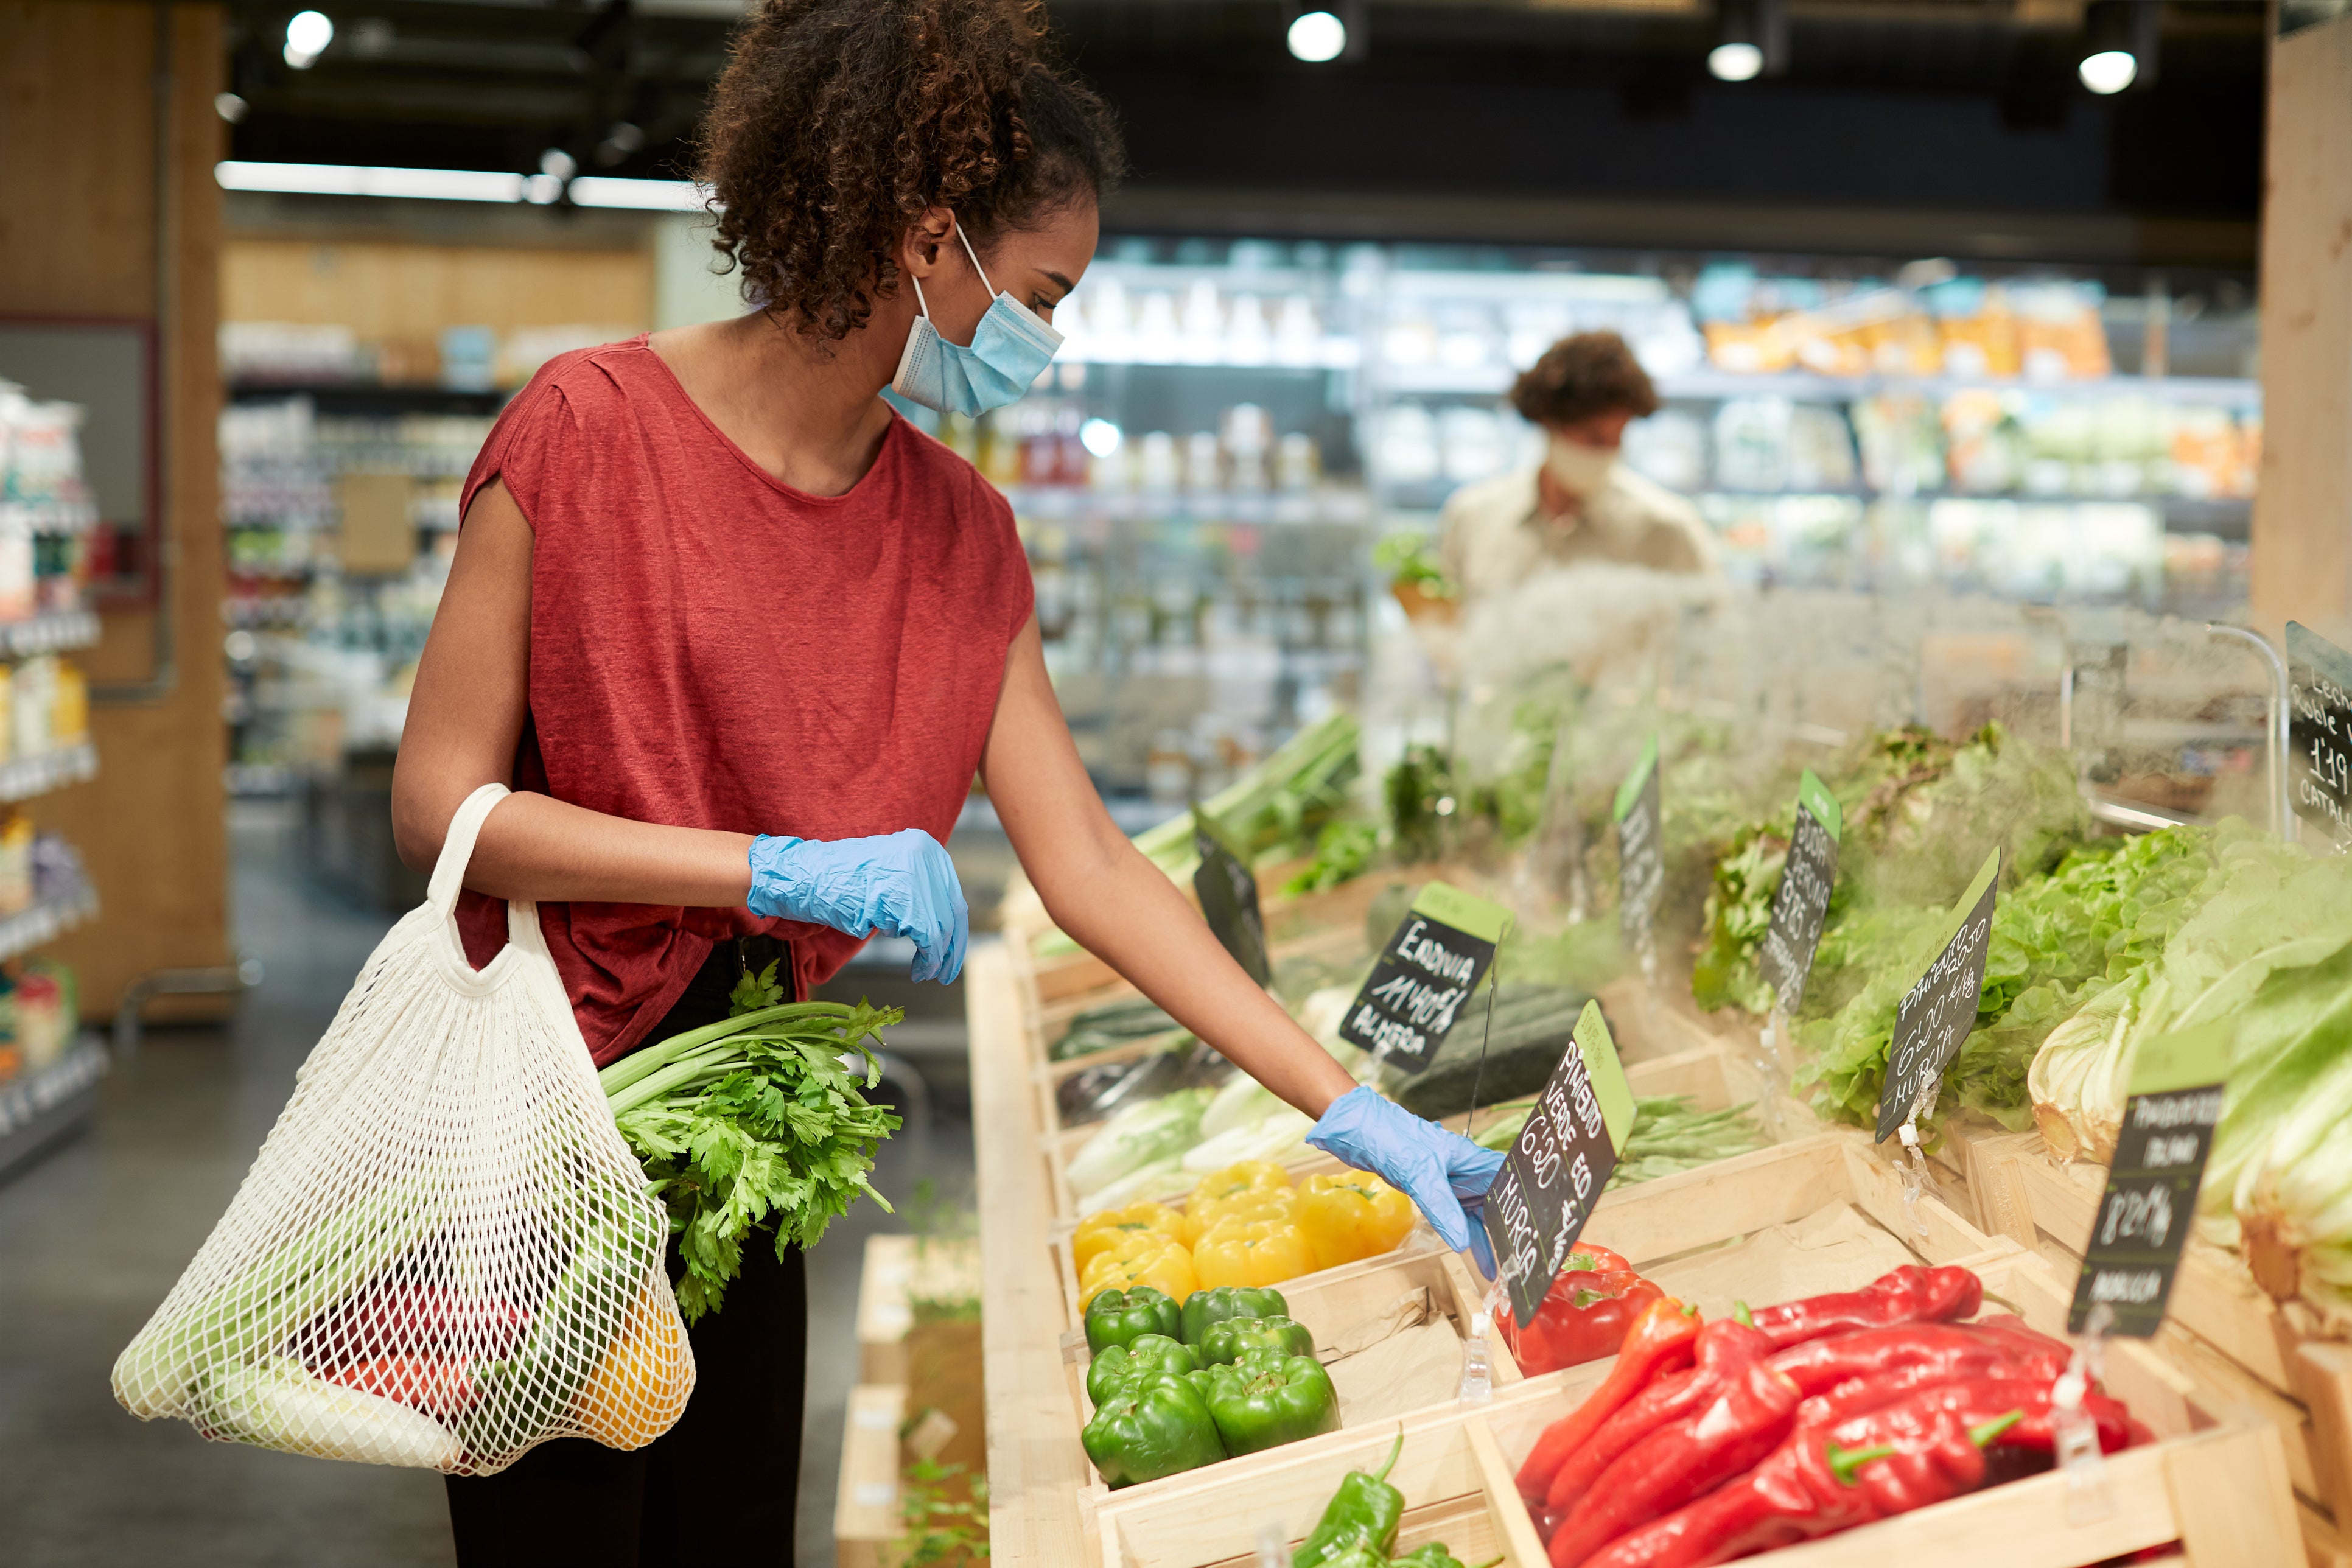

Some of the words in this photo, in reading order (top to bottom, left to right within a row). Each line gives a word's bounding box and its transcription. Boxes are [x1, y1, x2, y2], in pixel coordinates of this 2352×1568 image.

[2311, 667, 2352, 711] Lech
[1945, 917, 1986, 982] ROJO
[1546, 1080, 1577, 1151] VERDE
[1570, 1152, 1592, 1200] ECO
